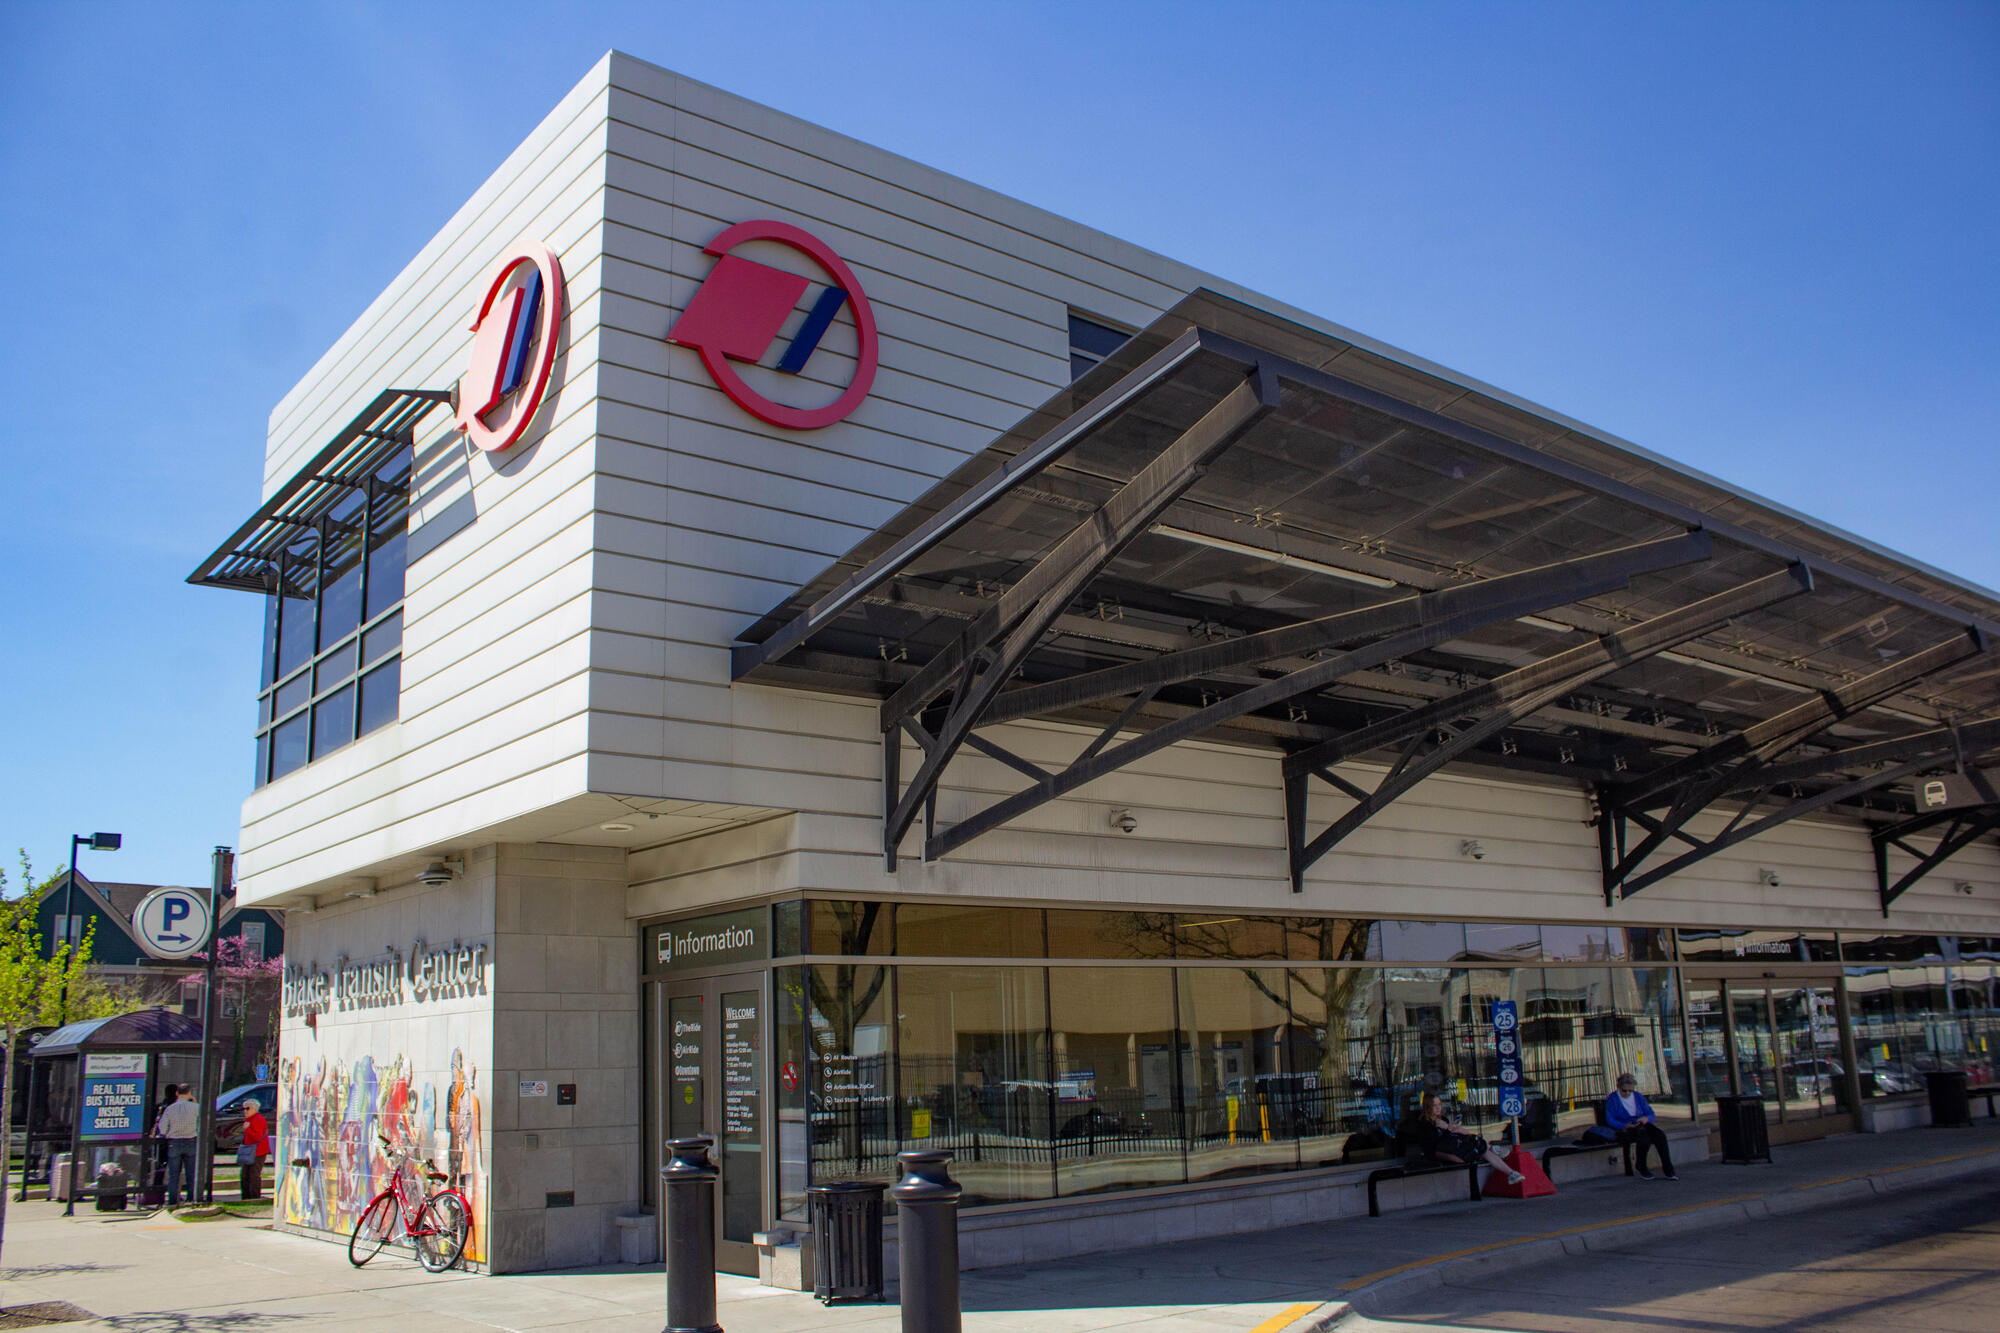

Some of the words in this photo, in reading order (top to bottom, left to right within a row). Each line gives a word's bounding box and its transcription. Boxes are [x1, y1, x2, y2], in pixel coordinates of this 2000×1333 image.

[164, 898, 190, 931] P
[675, 925, 753, 956] Information
[1744, 939, 1791, 954] Information
[283, 959, 329, 1008] Blake
[332, 945, 401, 1000] Transit
[404, 937, 488, 992] Center
[726, 1008, 756, 1019] WELCOME
[1498, 1015, 1512, 1027] 25
[1504, 1072, 1514, 1080] 27
[93, 1084, 114, 1094] REAL
[116, 1084, 136, 1094] TIME
[86, 1095, 102, 1106] BUS
[104, 1095, 141, 1105] TRACKER
[98, 1106, 126, 1117] INSIDE
[1506, 1101, 1520, 1113] 28
[94, 1118, 130, 1128] SHELTER
